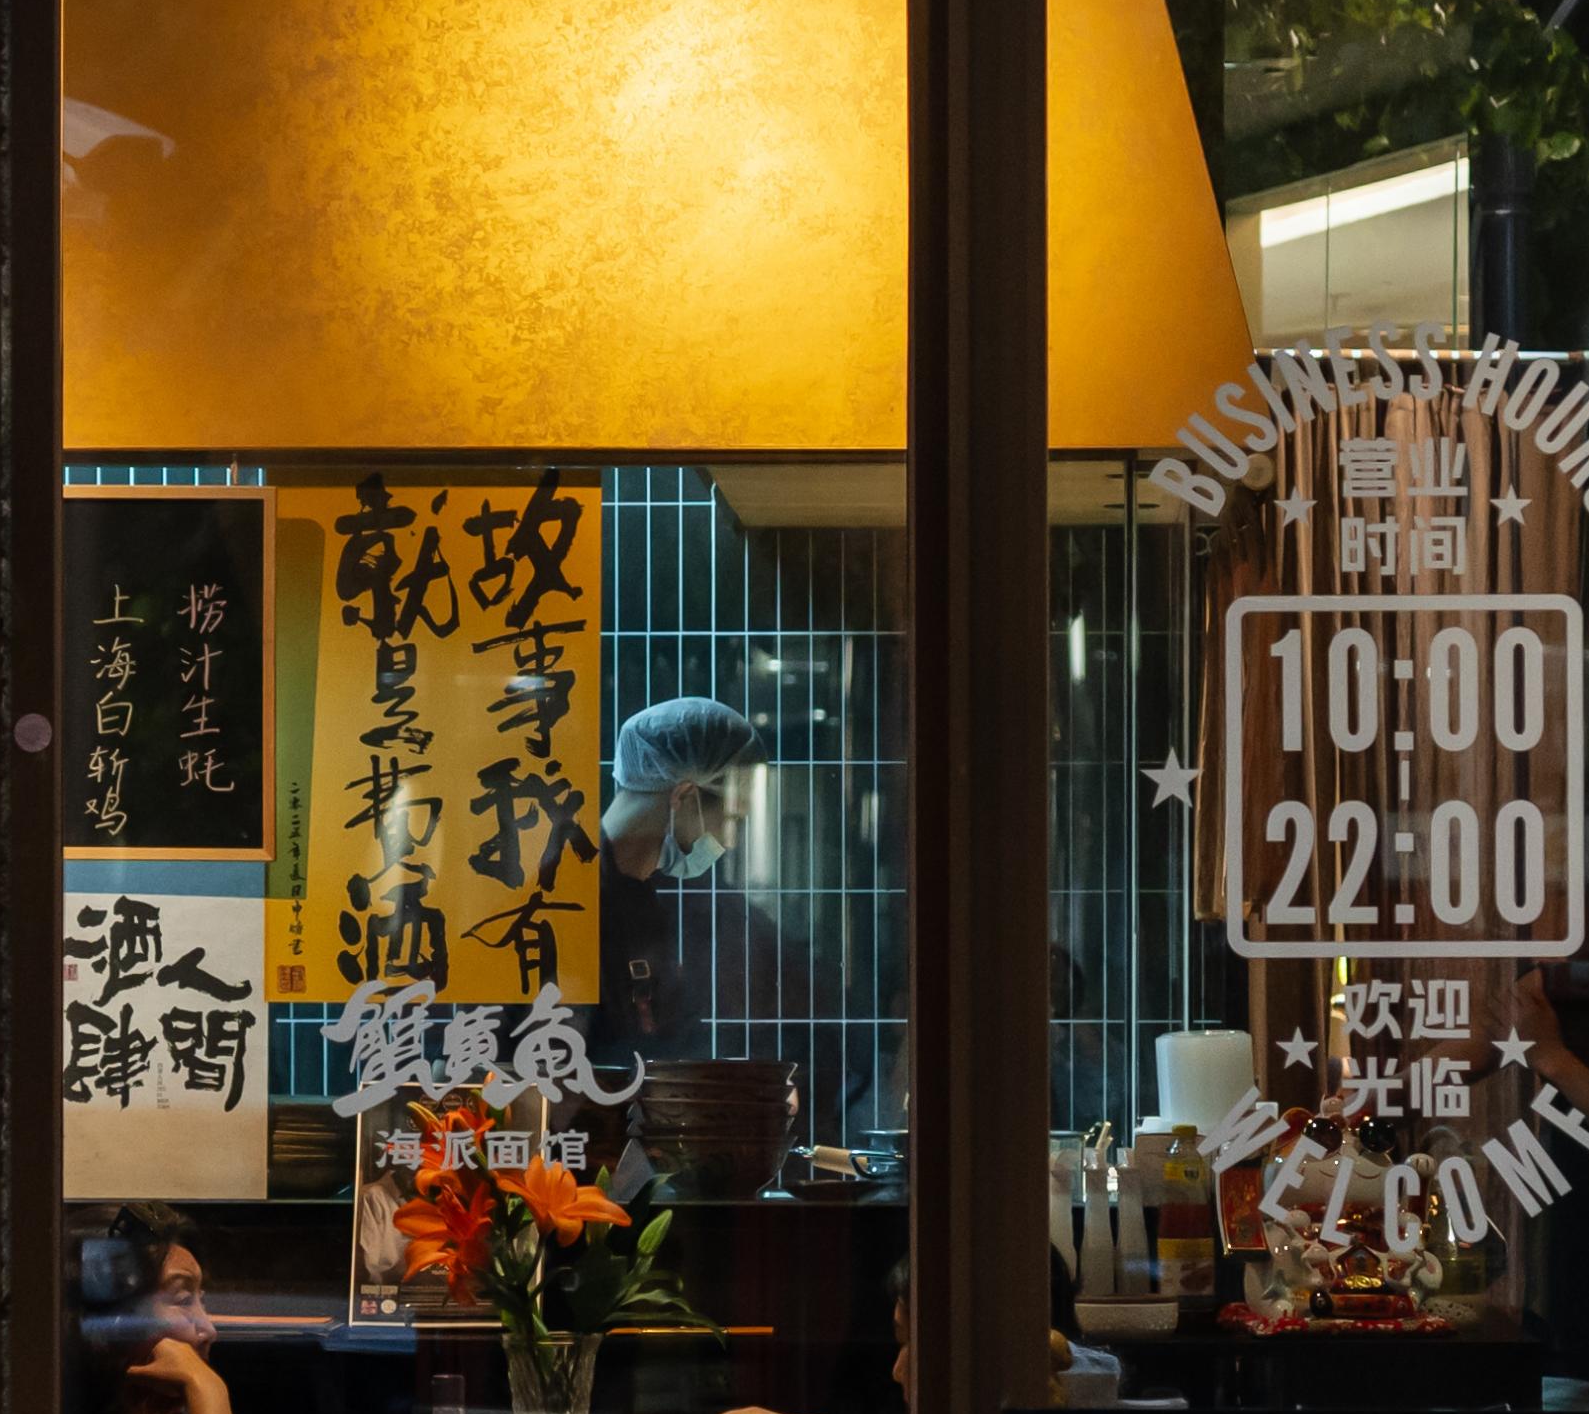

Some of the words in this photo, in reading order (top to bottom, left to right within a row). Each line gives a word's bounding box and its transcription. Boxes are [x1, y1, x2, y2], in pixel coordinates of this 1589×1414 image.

[1149, 320, 1447, 517] BUSINESS
[1339, 438, 1468, 499] 营业
[1340, 515, 1468, 576] 时间
[84, 584, 145, 836] 上海白斩鸡
[1269, 626, 1544, 753] 10:00
[1265, 799, 1544, 926] 22:00
[1343, 978, 1472, 1041] 欢迎
[1342, 1056, 1472, 1119] 光临
[374, 1129, 590, 1171] 海派面馆
